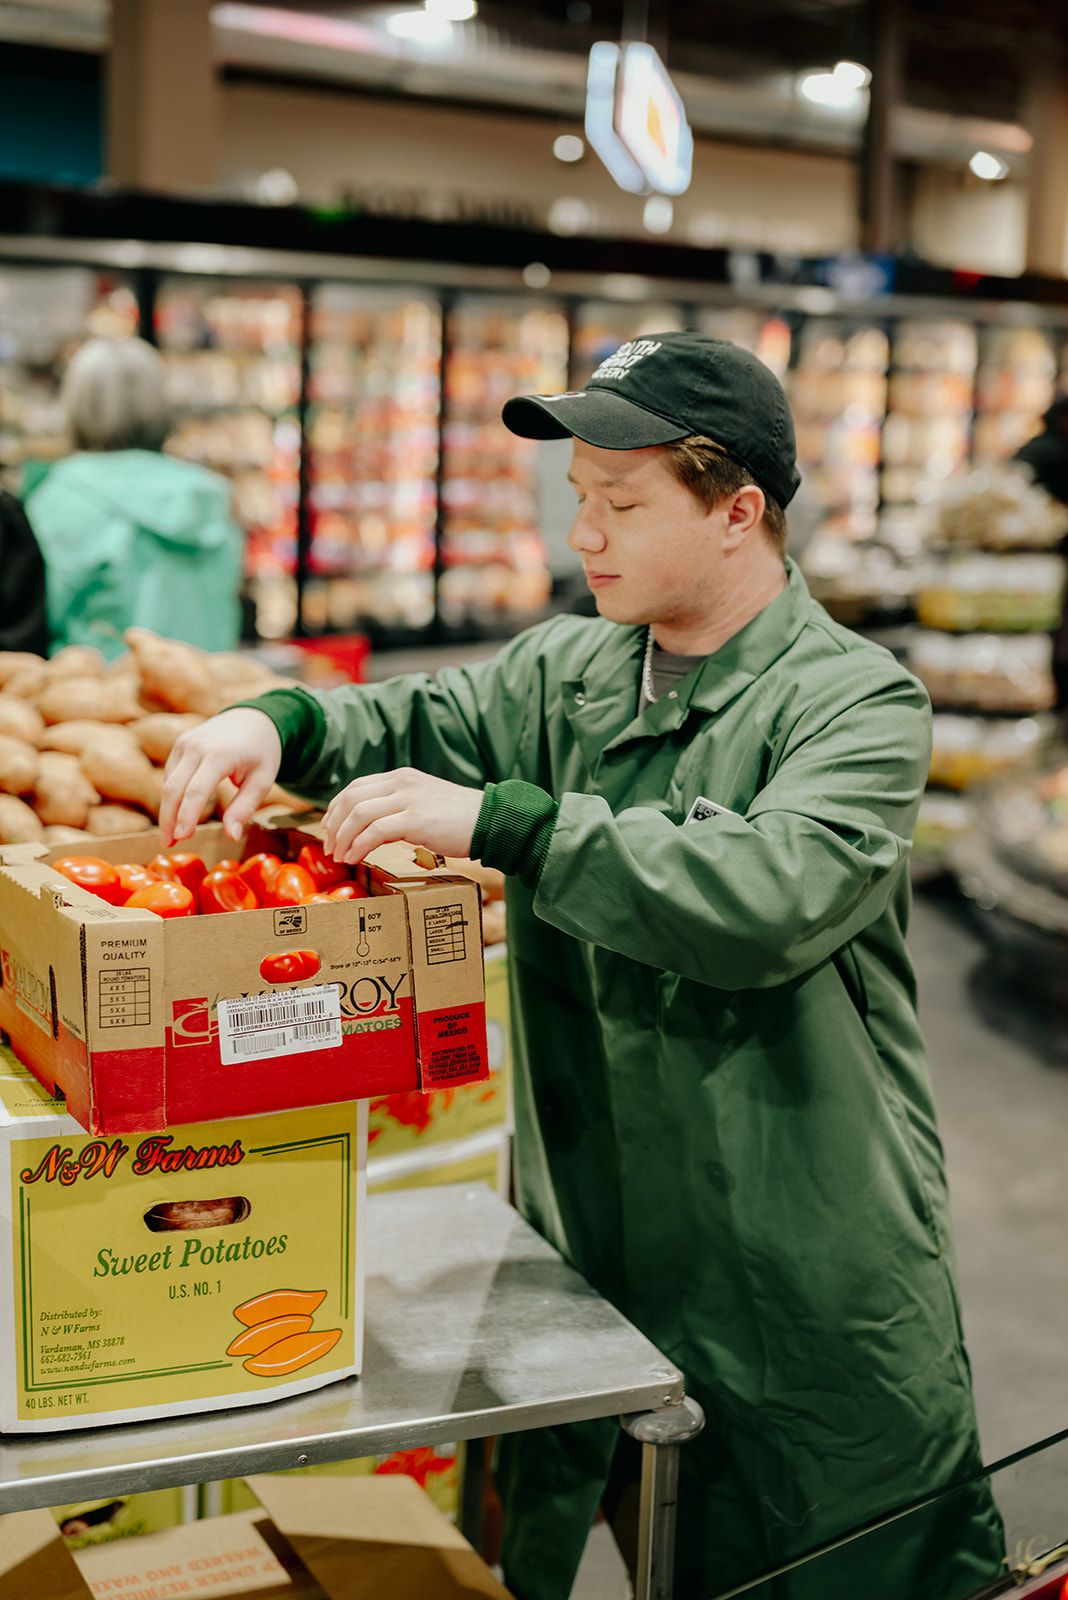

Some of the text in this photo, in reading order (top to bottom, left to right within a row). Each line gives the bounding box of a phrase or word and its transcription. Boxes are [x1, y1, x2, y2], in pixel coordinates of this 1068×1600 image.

[101, 939, 148, 949] PREMIUM
[102, 951, 146, 960] QUALITY
[433, 1012, 471, 1024] PRODUCE
[438, 1028, 468, 1038] MEXICO
[132, 1135, 245, 1176] Farms
[93, 1234, 288, 1278] Sweet Potatoes
[169, 1280, 222, 1299] U.S. NO. 1
[40, 1308, 103, 1321] Distributed by:
[40, 1326, 50, 1336] N
[40, 1336, 125, 1355] Vardaman, MS 38878
[40, 1351, 92, 1364] 662-682-7961
[40, 1358, 136, 1374] www.nandwfarms.com
[25, 1392, 89, 1409] 40 LBS. NET WT.
[187, 1549, 262, 1572] WASHED
[145, 1565, 183, 1581] AND
[196, 1566, 257, 1588] UNDER
